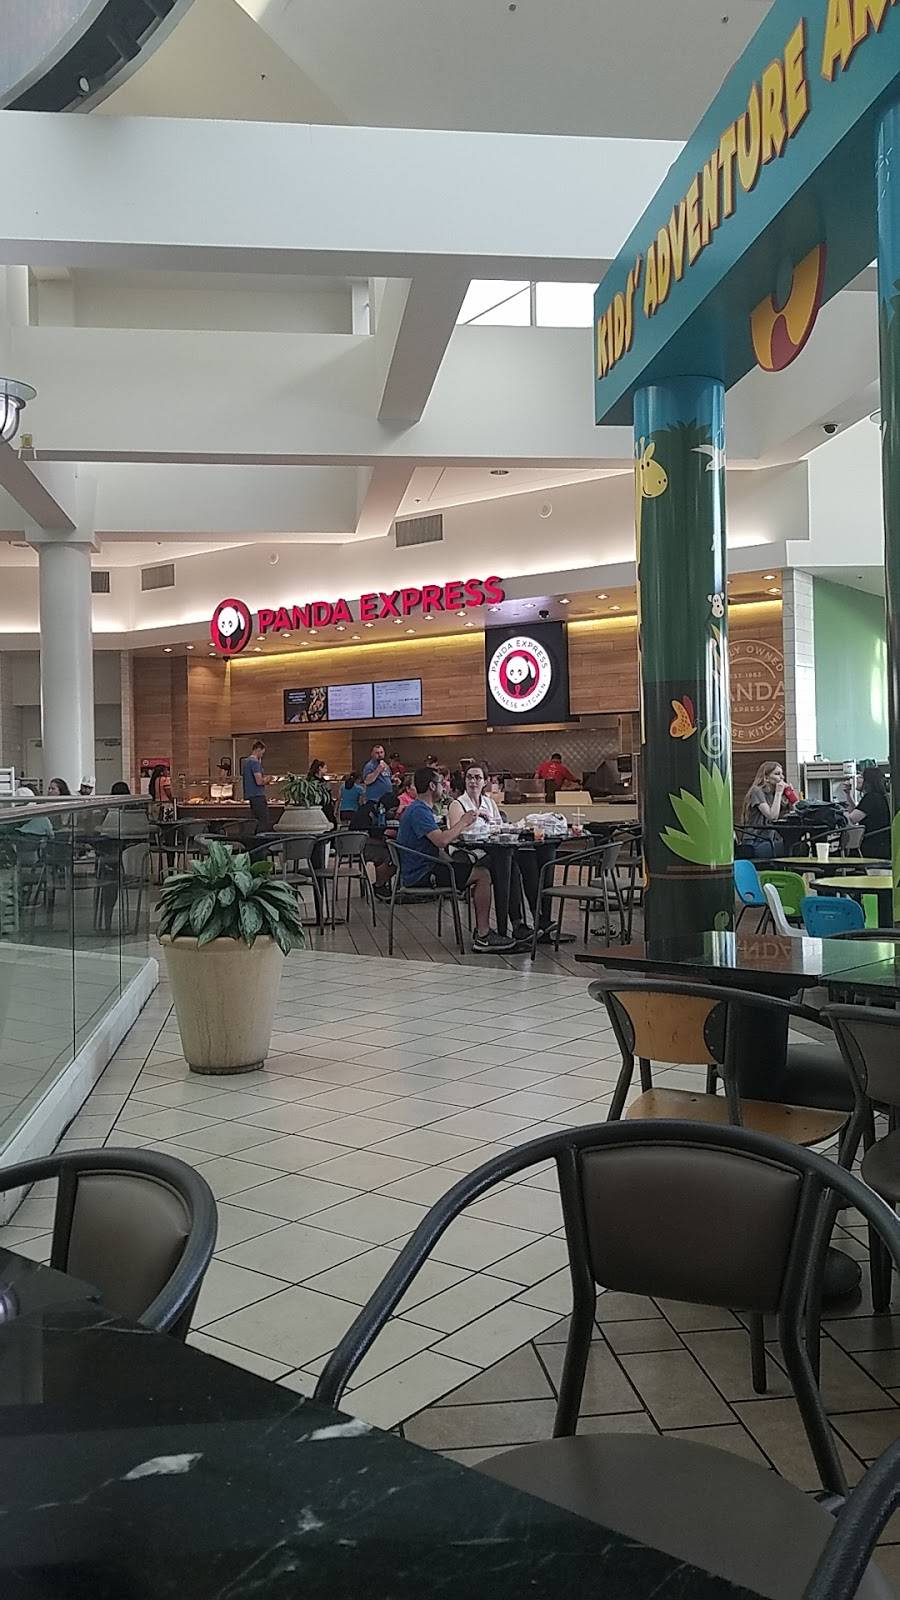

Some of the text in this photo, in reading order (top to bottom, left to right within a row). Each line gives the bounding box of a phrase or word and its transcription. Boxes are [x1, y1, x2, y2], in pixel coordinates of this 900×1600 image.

[597, 253, 643, 380] KIDS'
[643, 17, 809, 319] ADVENTURE
[257, 576, 506, 635] PANDA EXPRESS
[491, 640, 548, 673] PANDA EXPRESS
[746, 645, 783, 671] OWNED
[494, 683, 546, 708] CHINESE KITCHEN
